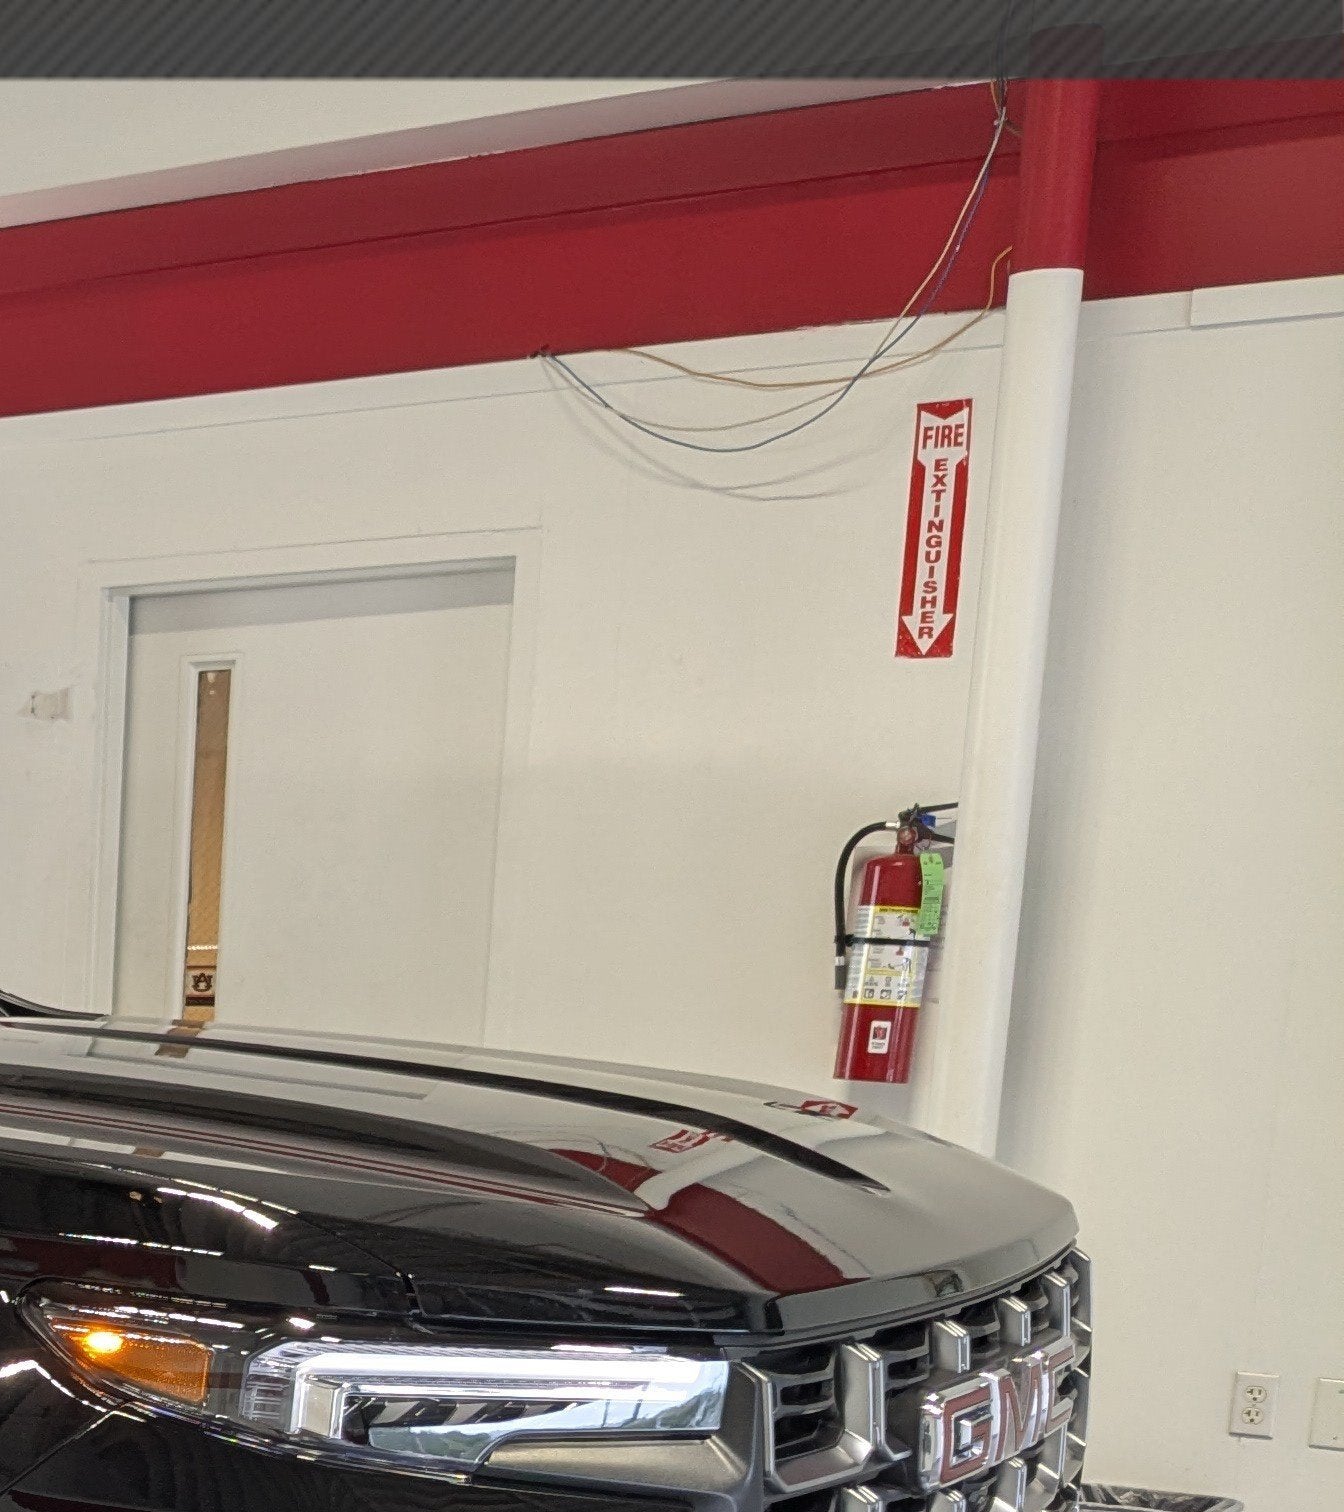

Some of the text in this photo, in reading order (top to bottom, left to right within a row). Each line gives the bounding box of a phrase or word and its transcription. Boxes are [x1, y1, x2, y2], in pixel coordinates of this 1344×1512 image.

[922, 423, 965, 450] FIRE
[917, 458, 949, 640] EXTINGUISHER
[923, 1337, 1075, 1488] GMC
